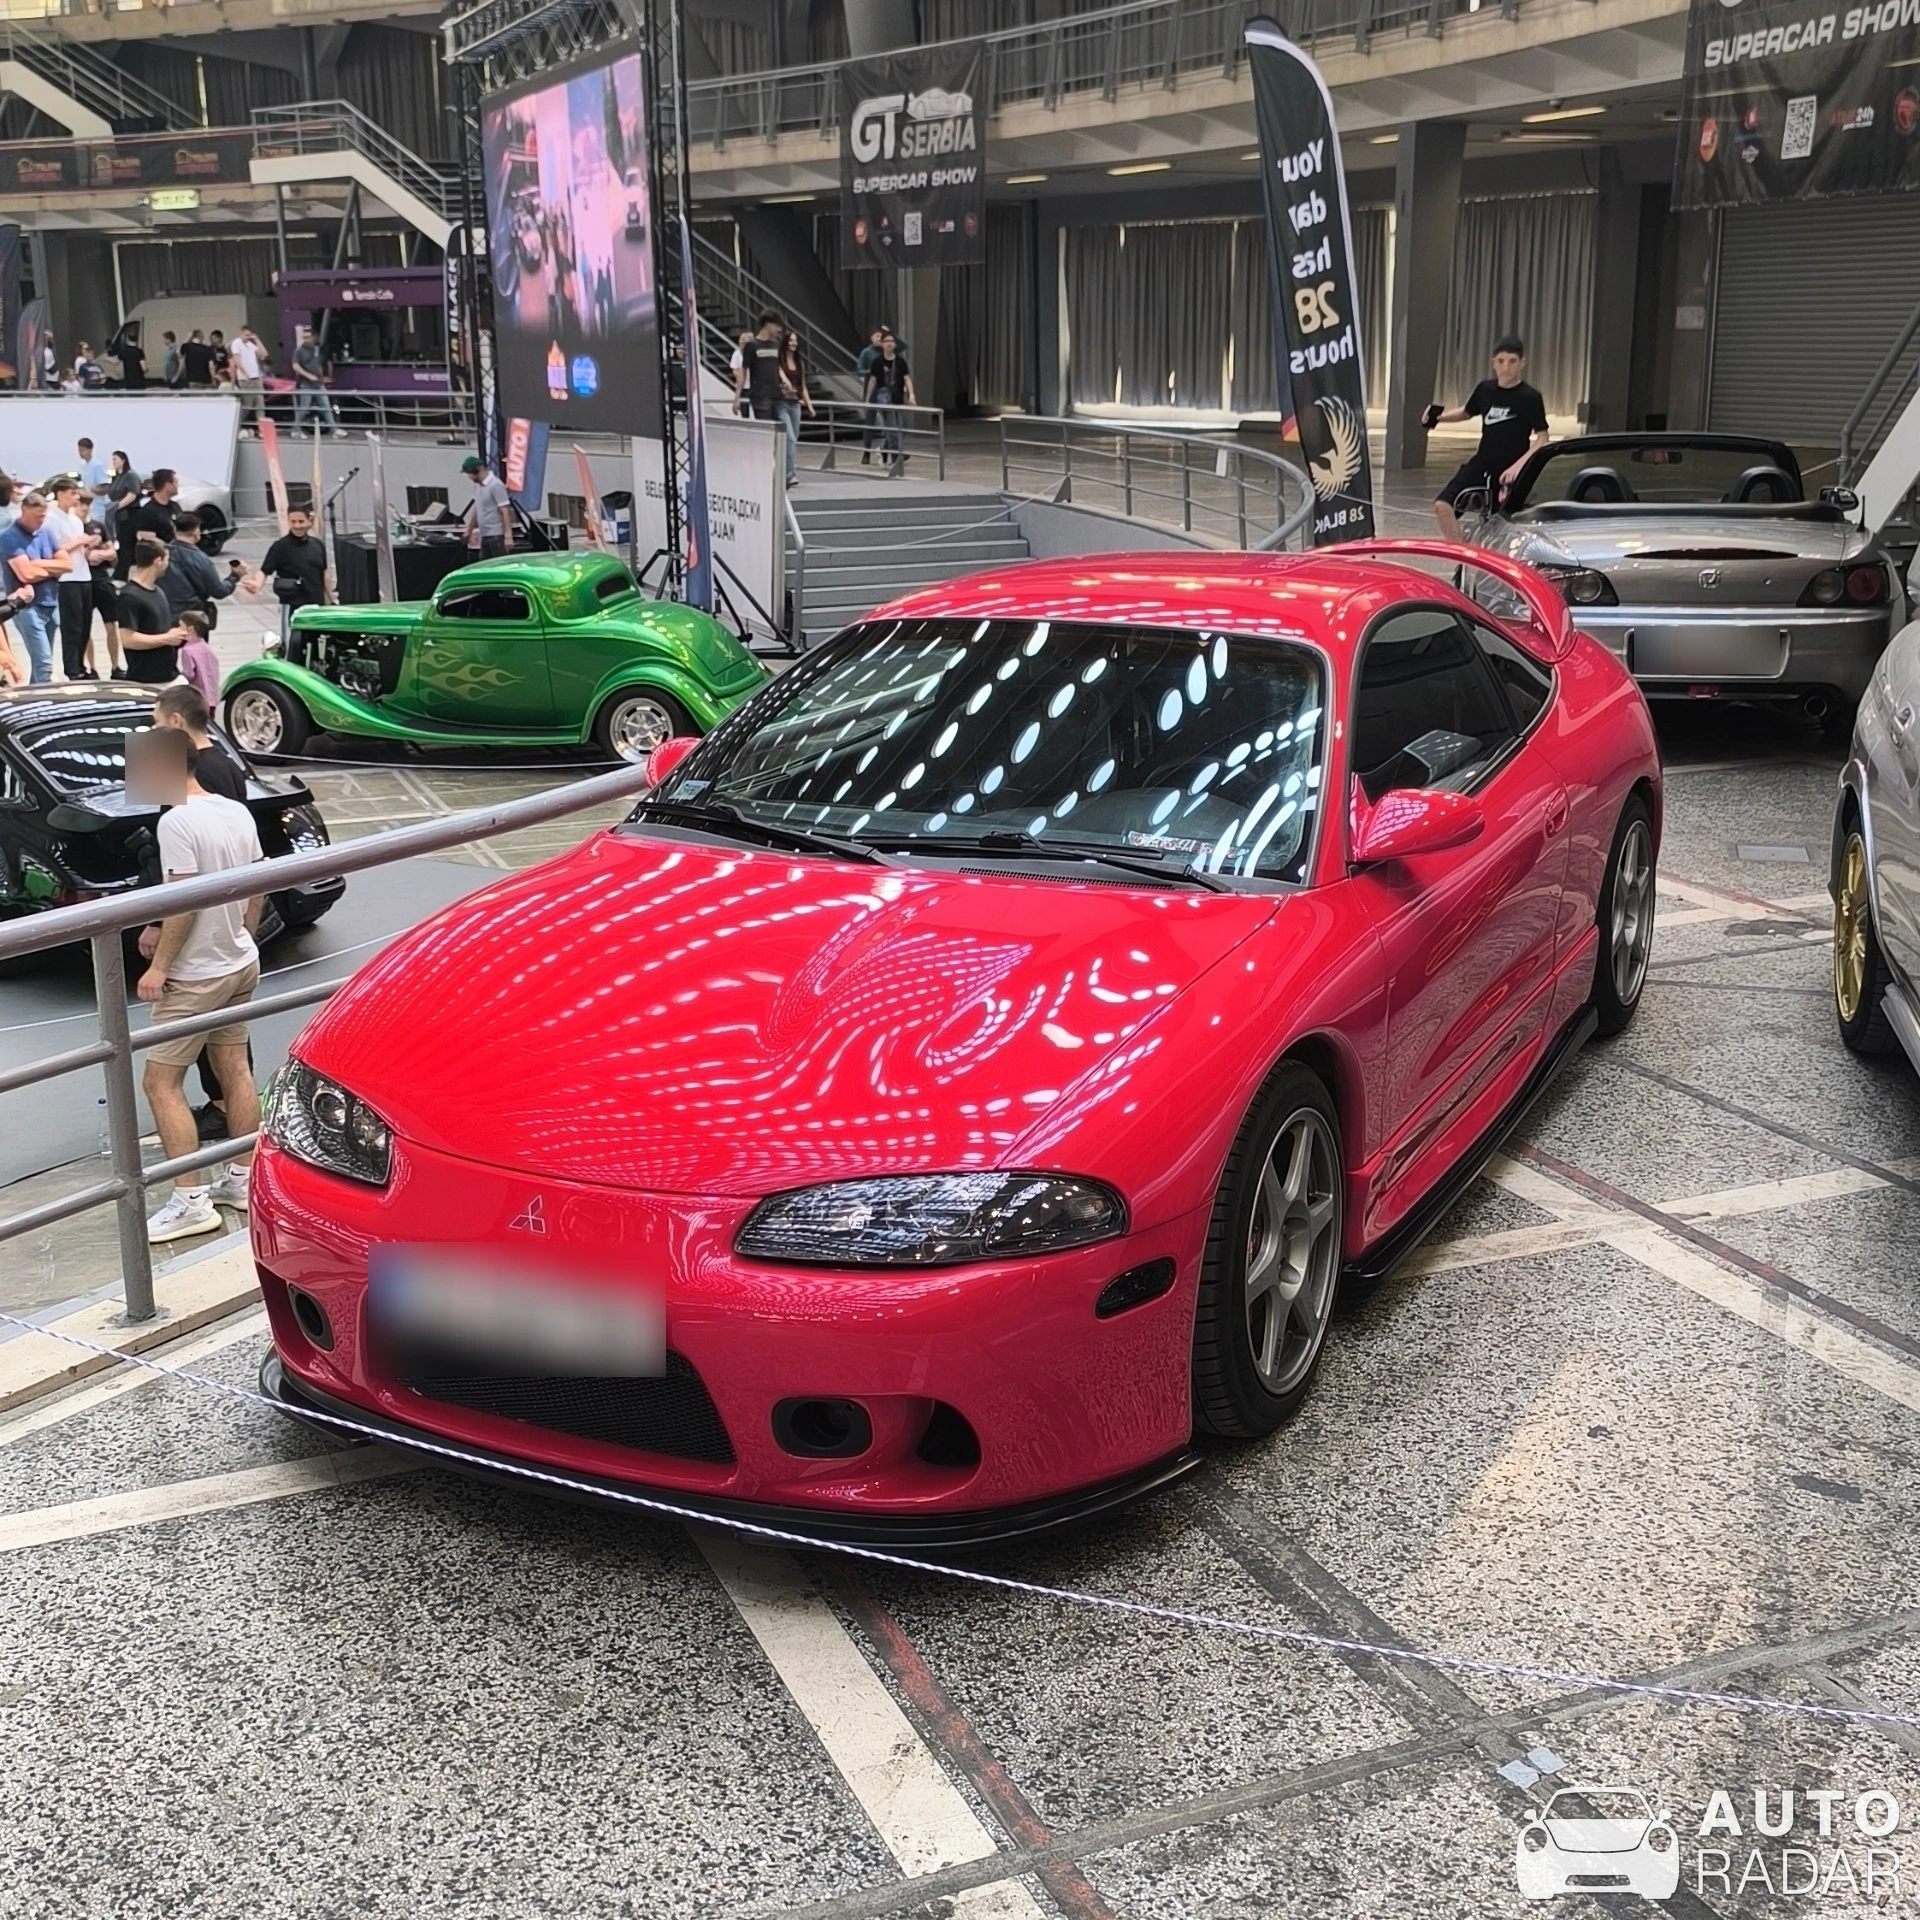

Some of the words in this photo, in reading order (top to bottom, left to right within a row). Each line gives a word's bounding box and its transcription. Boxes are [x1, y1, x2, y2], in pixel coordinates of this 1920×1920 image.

[1704, 14, 1836, 68] SUPERCAR
[1841, 0, 1920, 40] SHOW
[851, 94, 905, 163] GT
[901, 117, 976, 159] SERBIA
[853, 171, 928, 194] SUPERCAR
[931, 165, 977, 187] SHOW
[448, 257, 459, 332] BLACK
[506, 431, 528, 485] AUTO
